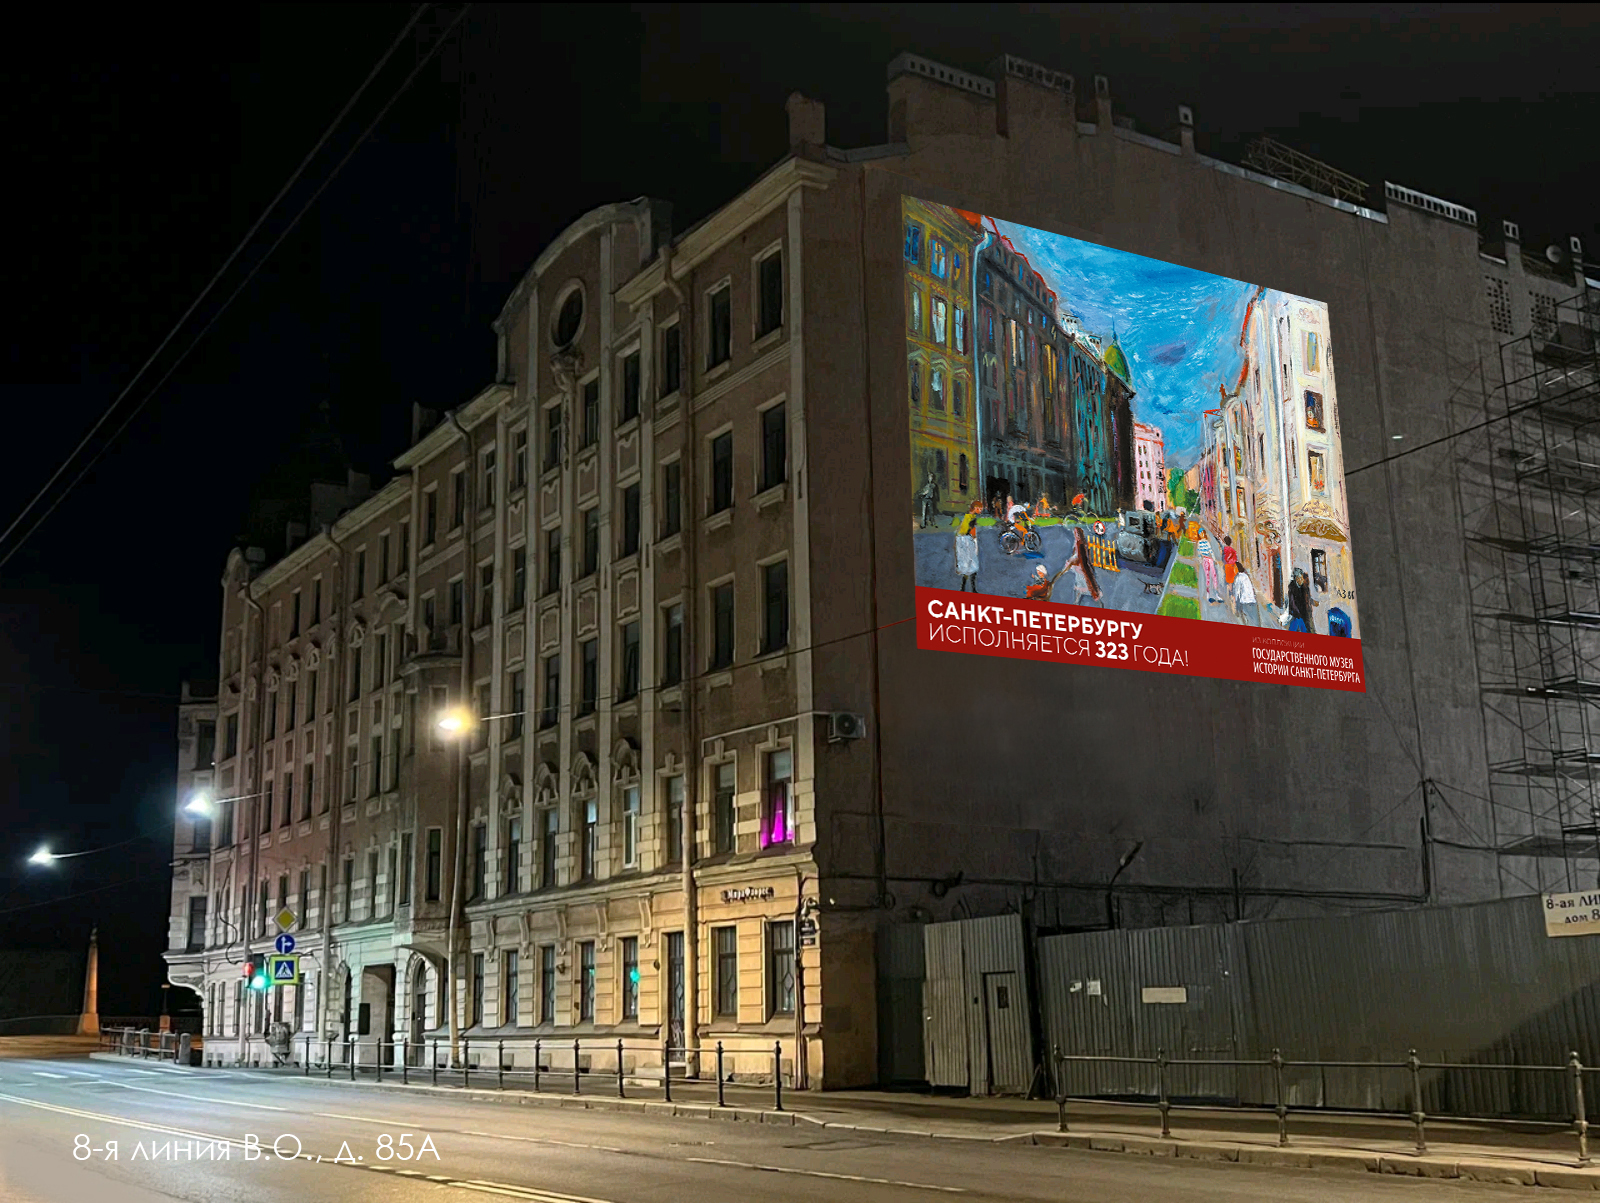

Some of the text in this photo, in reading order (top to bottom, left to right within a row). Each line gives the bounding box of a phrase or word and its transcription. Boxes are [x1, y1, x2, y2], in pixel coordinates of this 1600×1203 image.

[927, 599, 1143, 640] САНКТ-ПЕТЕРБУРГУ
[929, 622, 1190, 667] ИСПОЛНЯЕТСЯ 323 ГОДА!
[1252, 647, 1354, 669] ГОСУДАРСТВЕННОГО МУЗЕЯ
[1253, 661, 1361, 684] ИСТОРИИ САНКТ-ПЕТЕРБУРГА
[1546, 894, 1600, 910] 8-ая ЛИ
[1591, 909, 1600, 920] 8
